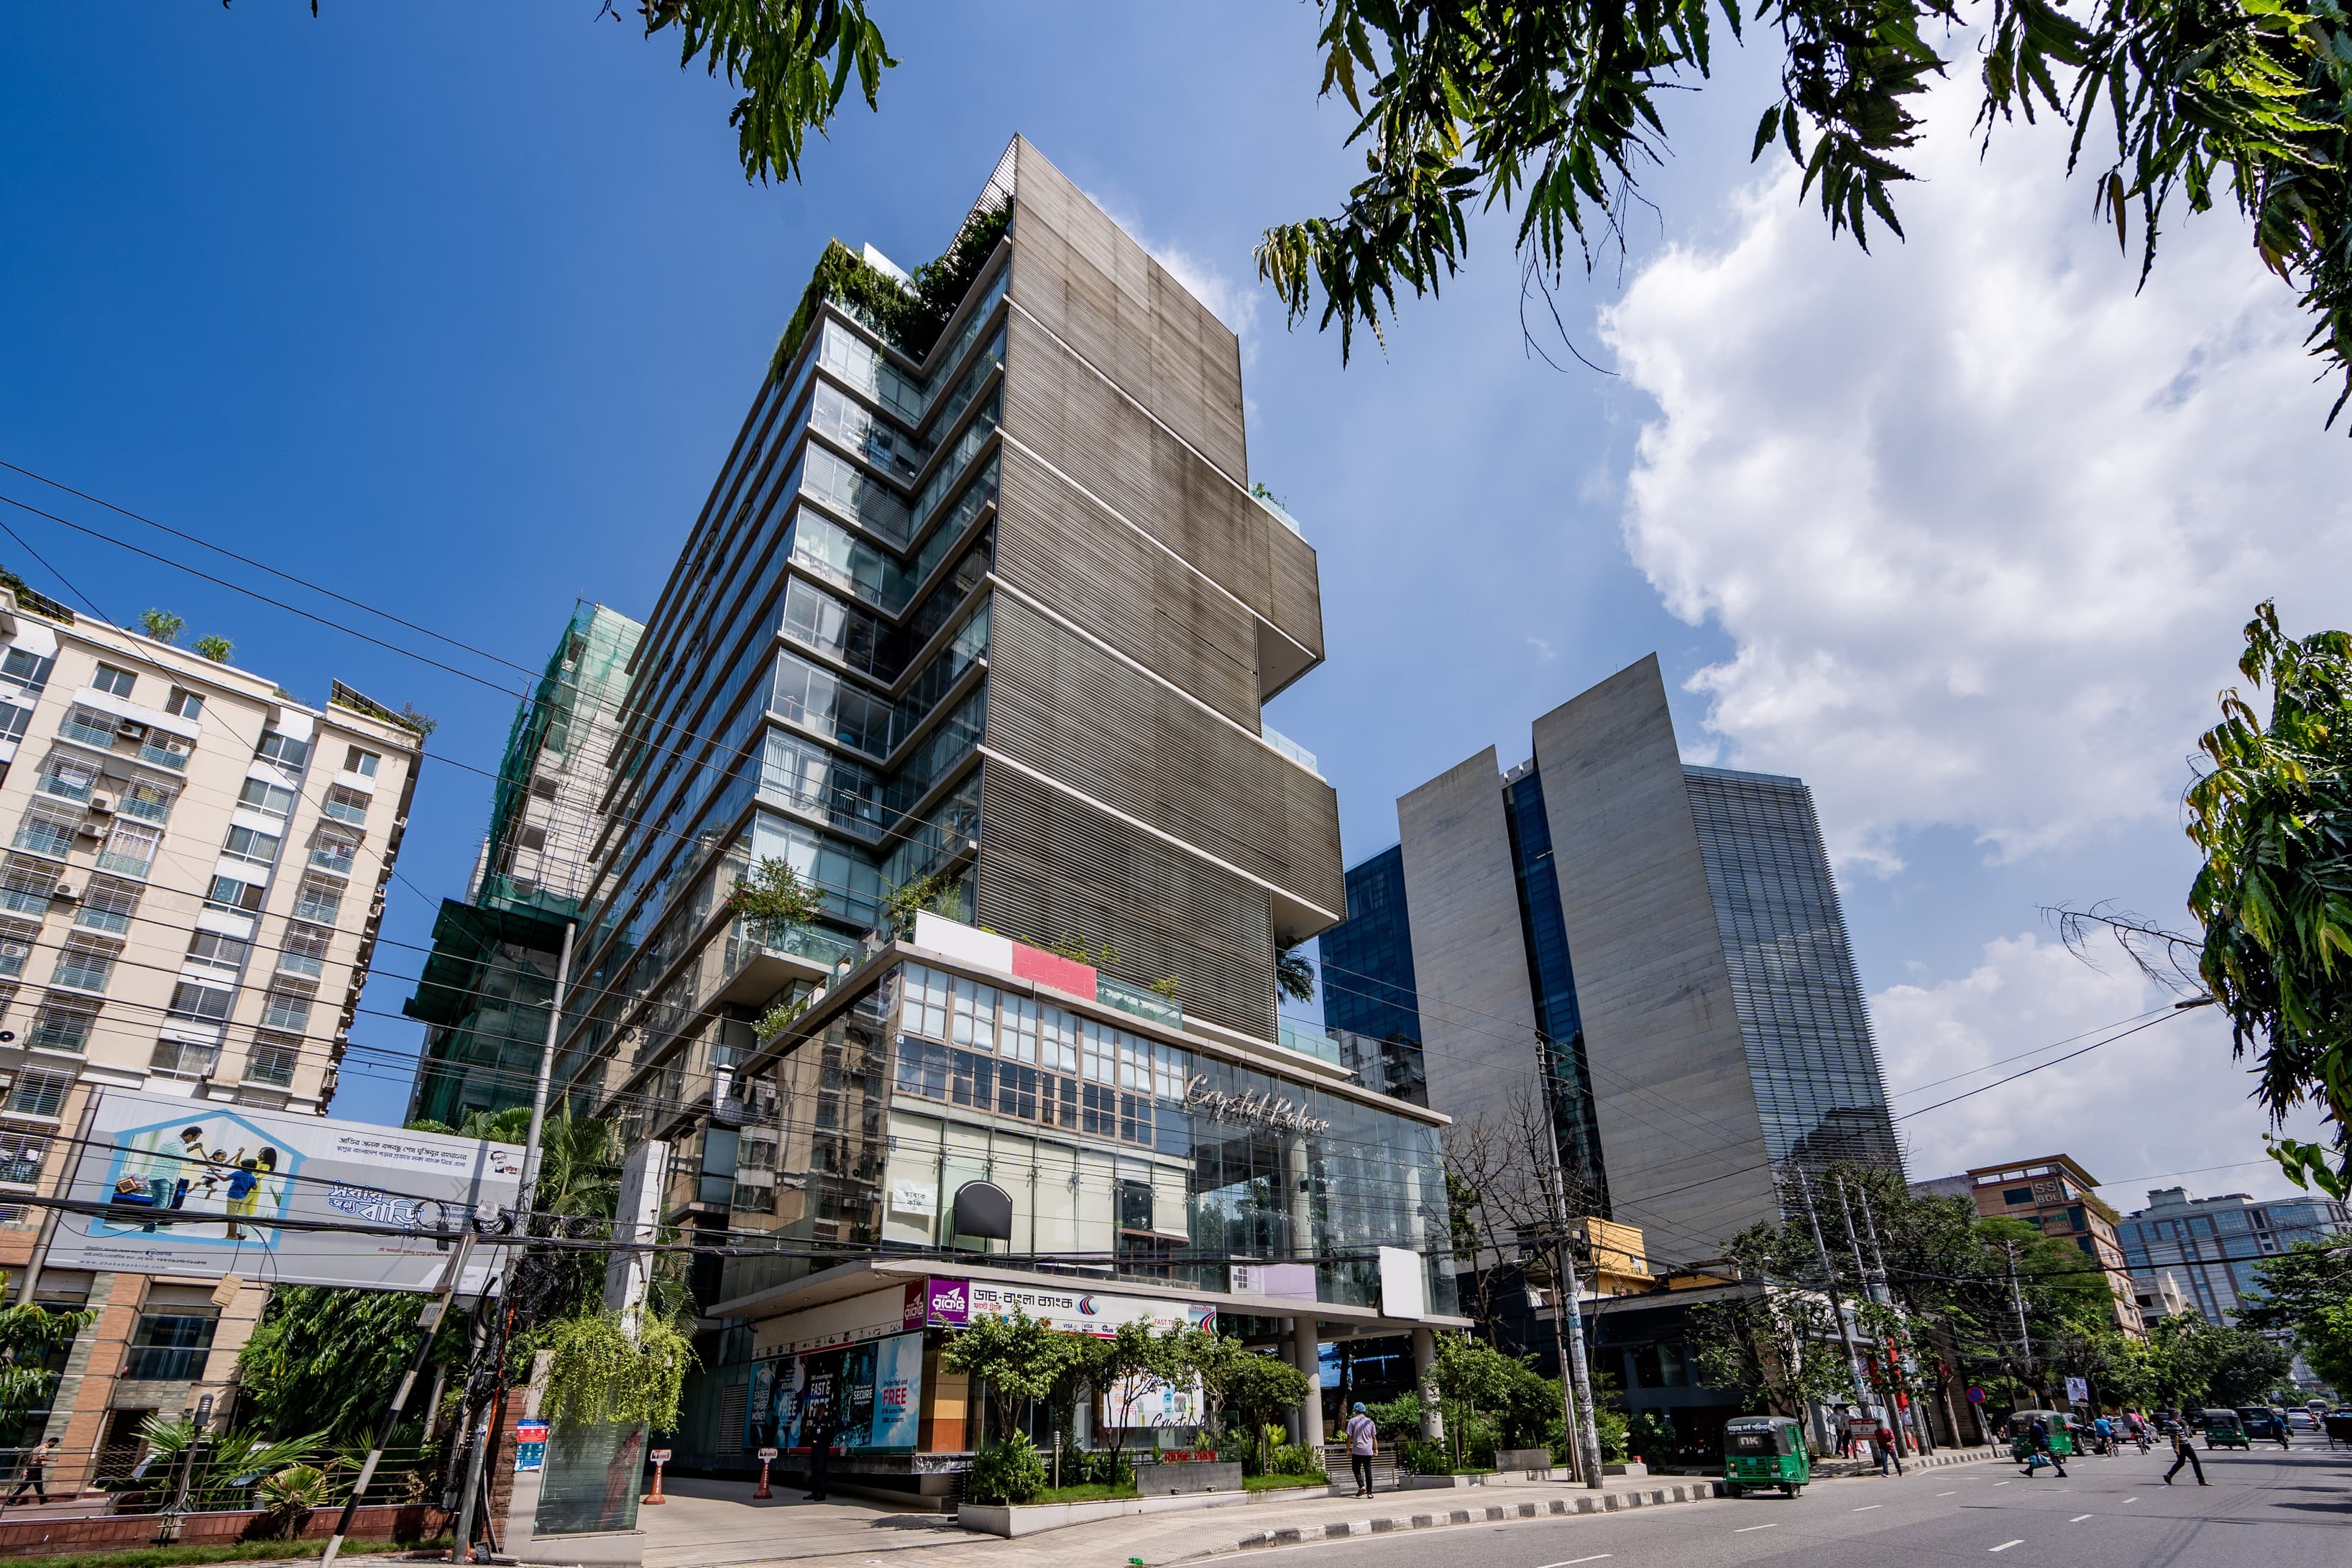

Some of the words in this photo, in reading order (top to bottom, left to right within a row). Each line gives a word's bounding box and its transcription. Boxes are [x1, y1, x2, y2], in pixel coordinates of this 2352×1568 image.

[1186, 1073, 1271, 1122] Crystal
[1269, 1096, 1330, 1135] Palace
[339, 1137, 359, 1145] জাতির
[417, 1148, 439, 1156] মুজিবুর
[441, 1151, 467, 1160] রহমানের
[329, 1198, 358, 1214] জন্য
[357, 1198, 425, 1231] বাড়ি
[1038, 1296, 1073, 1309] ব্যাংক
[810, 1381, 826, 1396] FAST
[853, 1388, 873, 1401] SECURE
[883, 1387, 907, 1406] FREE
[1186, 1436, 1196, 1445] 22
